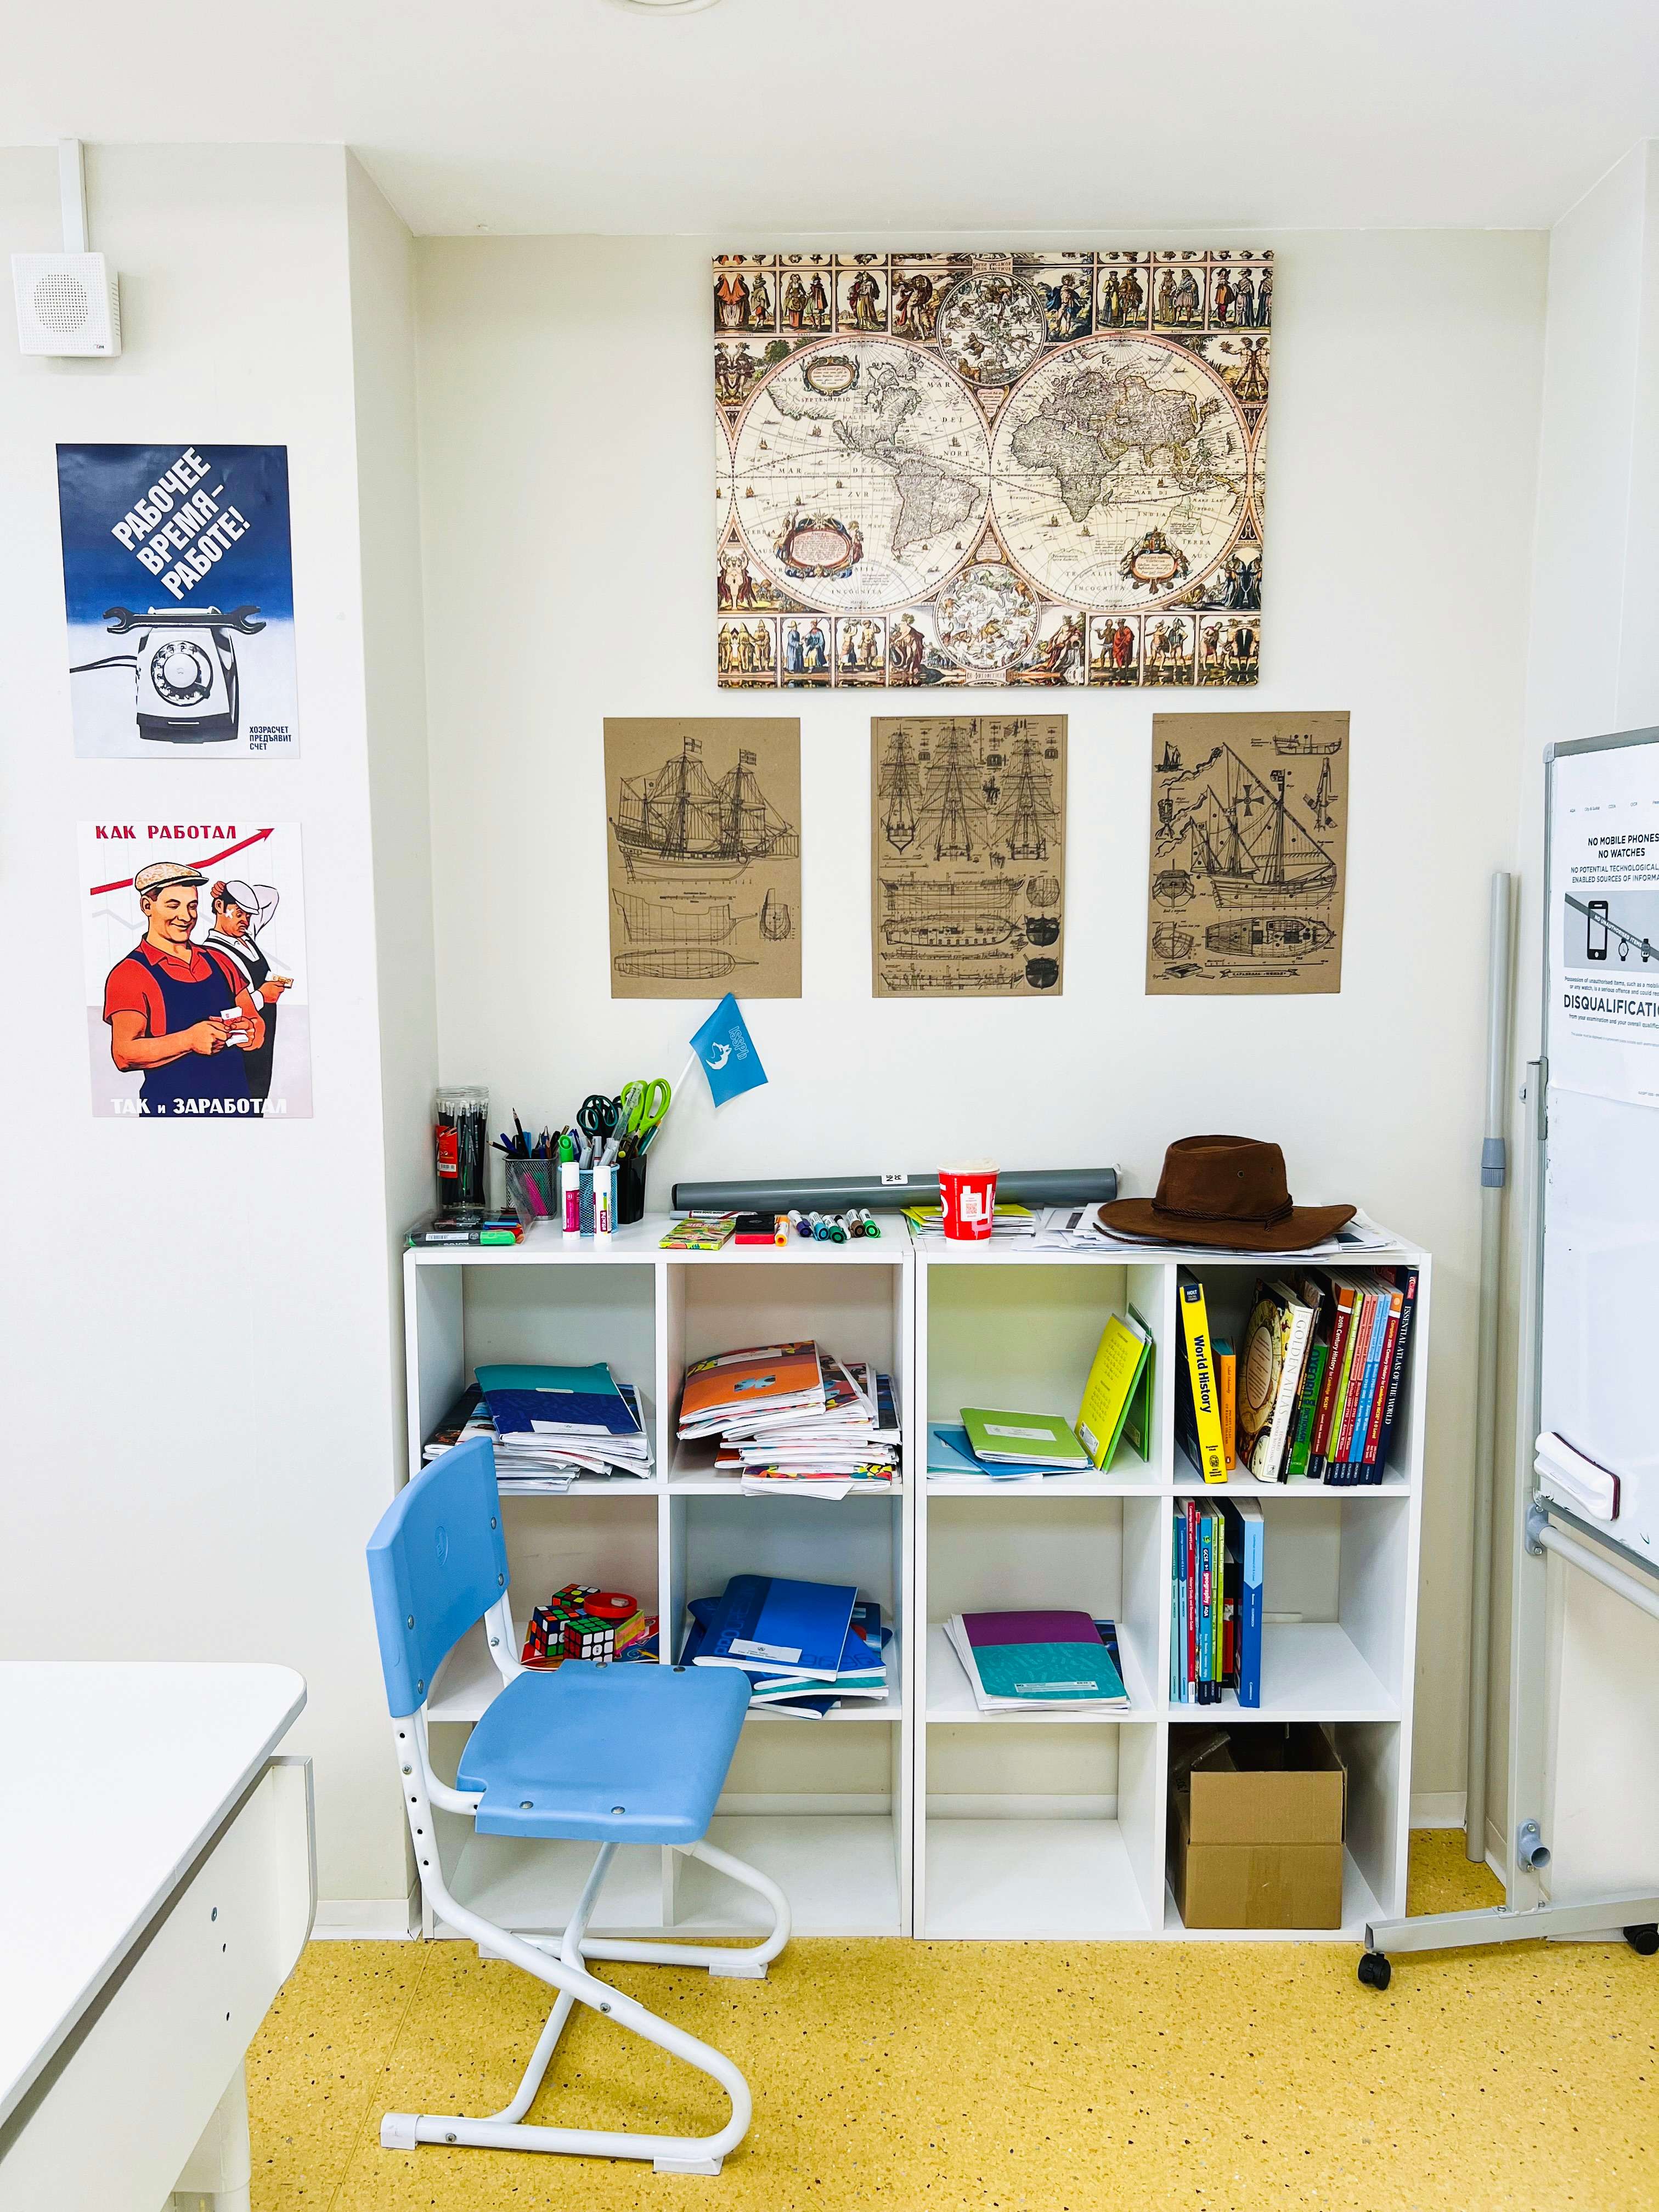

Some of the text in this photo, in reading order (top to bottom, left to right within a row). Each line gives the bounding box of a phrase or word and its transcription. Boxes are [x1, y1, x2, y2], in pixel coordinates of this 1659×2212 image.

[111, 447, 211, 551] РАБОЧЕЕ
[161, 505, 250, 600] РАБОТЕ!
[250, 726, 289, 734] ХОЗРАСЧЕТ
[250, 734, 292, 743] ПРЕДЪЯВИТ
[250, 742, 267, 751] СЧЕТ
[95, 825, 236, 839] КАК РАБОТАЛ
[1588, 833, 1659, 846] NO MOBILE PHONES
[1599, 848, 1645, 859] NO WATCHES
[1610, 864, 1659, 872] TECHNOLOGICAL
[1564, 994, 1659, 1017] DISQUALIFICATI
[729, 1026, 749, 1060] ISSPb
[111, 1098, 287, 1114] ТАК и ЗАРАБОТАЛ
[1406, 1282, 1415, 1299] Collins
[1333, 1329, 1342, 1350] Century
[1278, 1319, 1307, 1415] GOLDEN ATLAS
[1329, 1351, 1339, 1371] History
[1385, 1306, 1412, 1425] ESSENTIAL ATLAS OF THE WORLD
[1193, 1335, 1211, 1413] World History
[1298, 1349, 1320, 1443] OXFORD DICTIONARY
